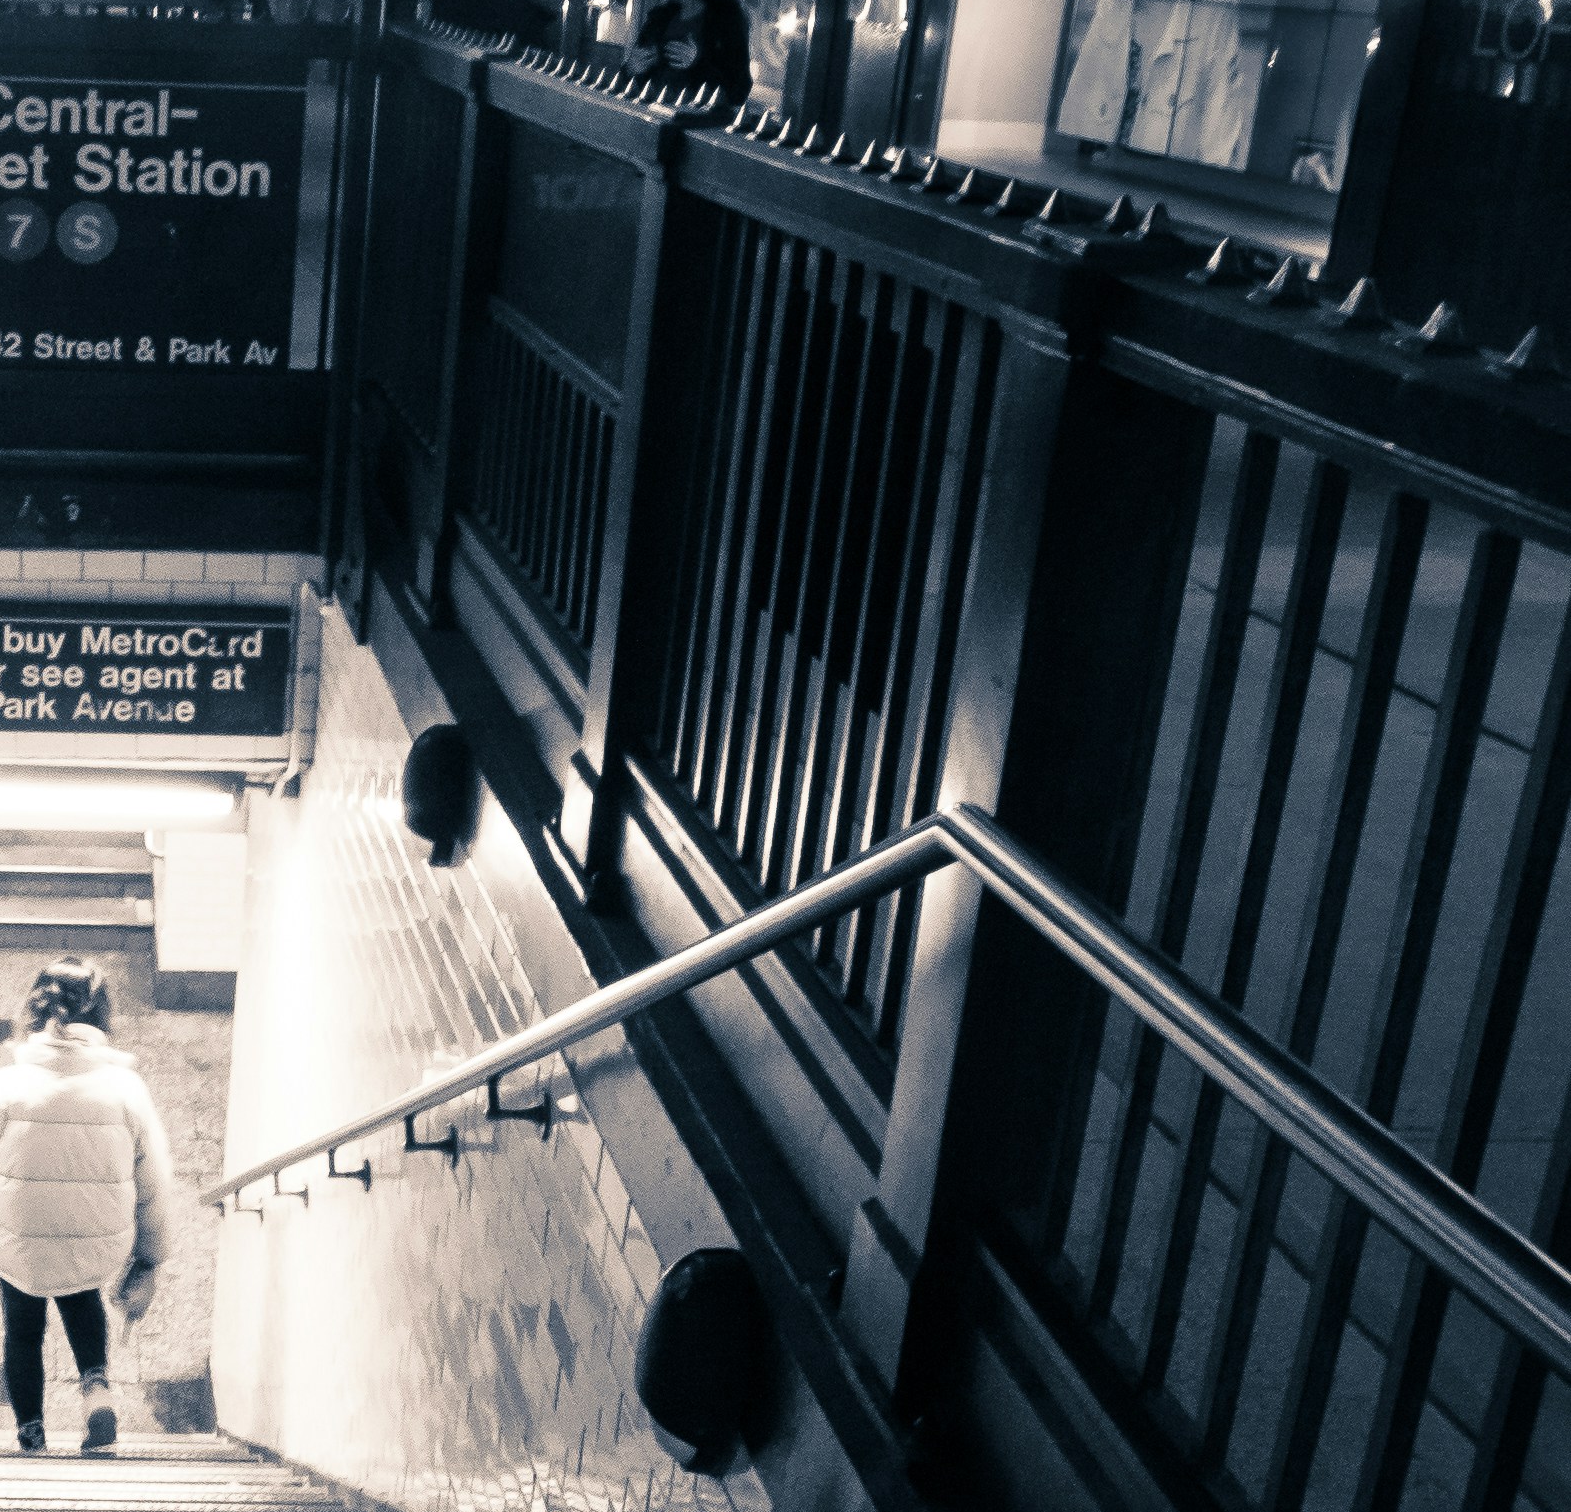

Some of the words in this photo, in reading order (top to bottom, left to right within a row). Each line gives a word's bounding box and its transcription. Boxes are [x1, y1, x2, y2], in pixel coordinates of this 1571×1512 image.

[73, 143, 271, 198] Station
[7, 214, 32, 249] 7
[73, 215, 103, 250] S
[33, 332, 123, 360] Street
[134, 337, 156, 362] &
[168, 338, 230, 364] Park
[243, 340, 278, 367] Av
[3, 625, 66, 659] buy
[20, 665, 84, 689] see
[99, 663, 198, 694] agent
[211, 666, 245, 690] at
[72, 693, 195, 722] Avenue
